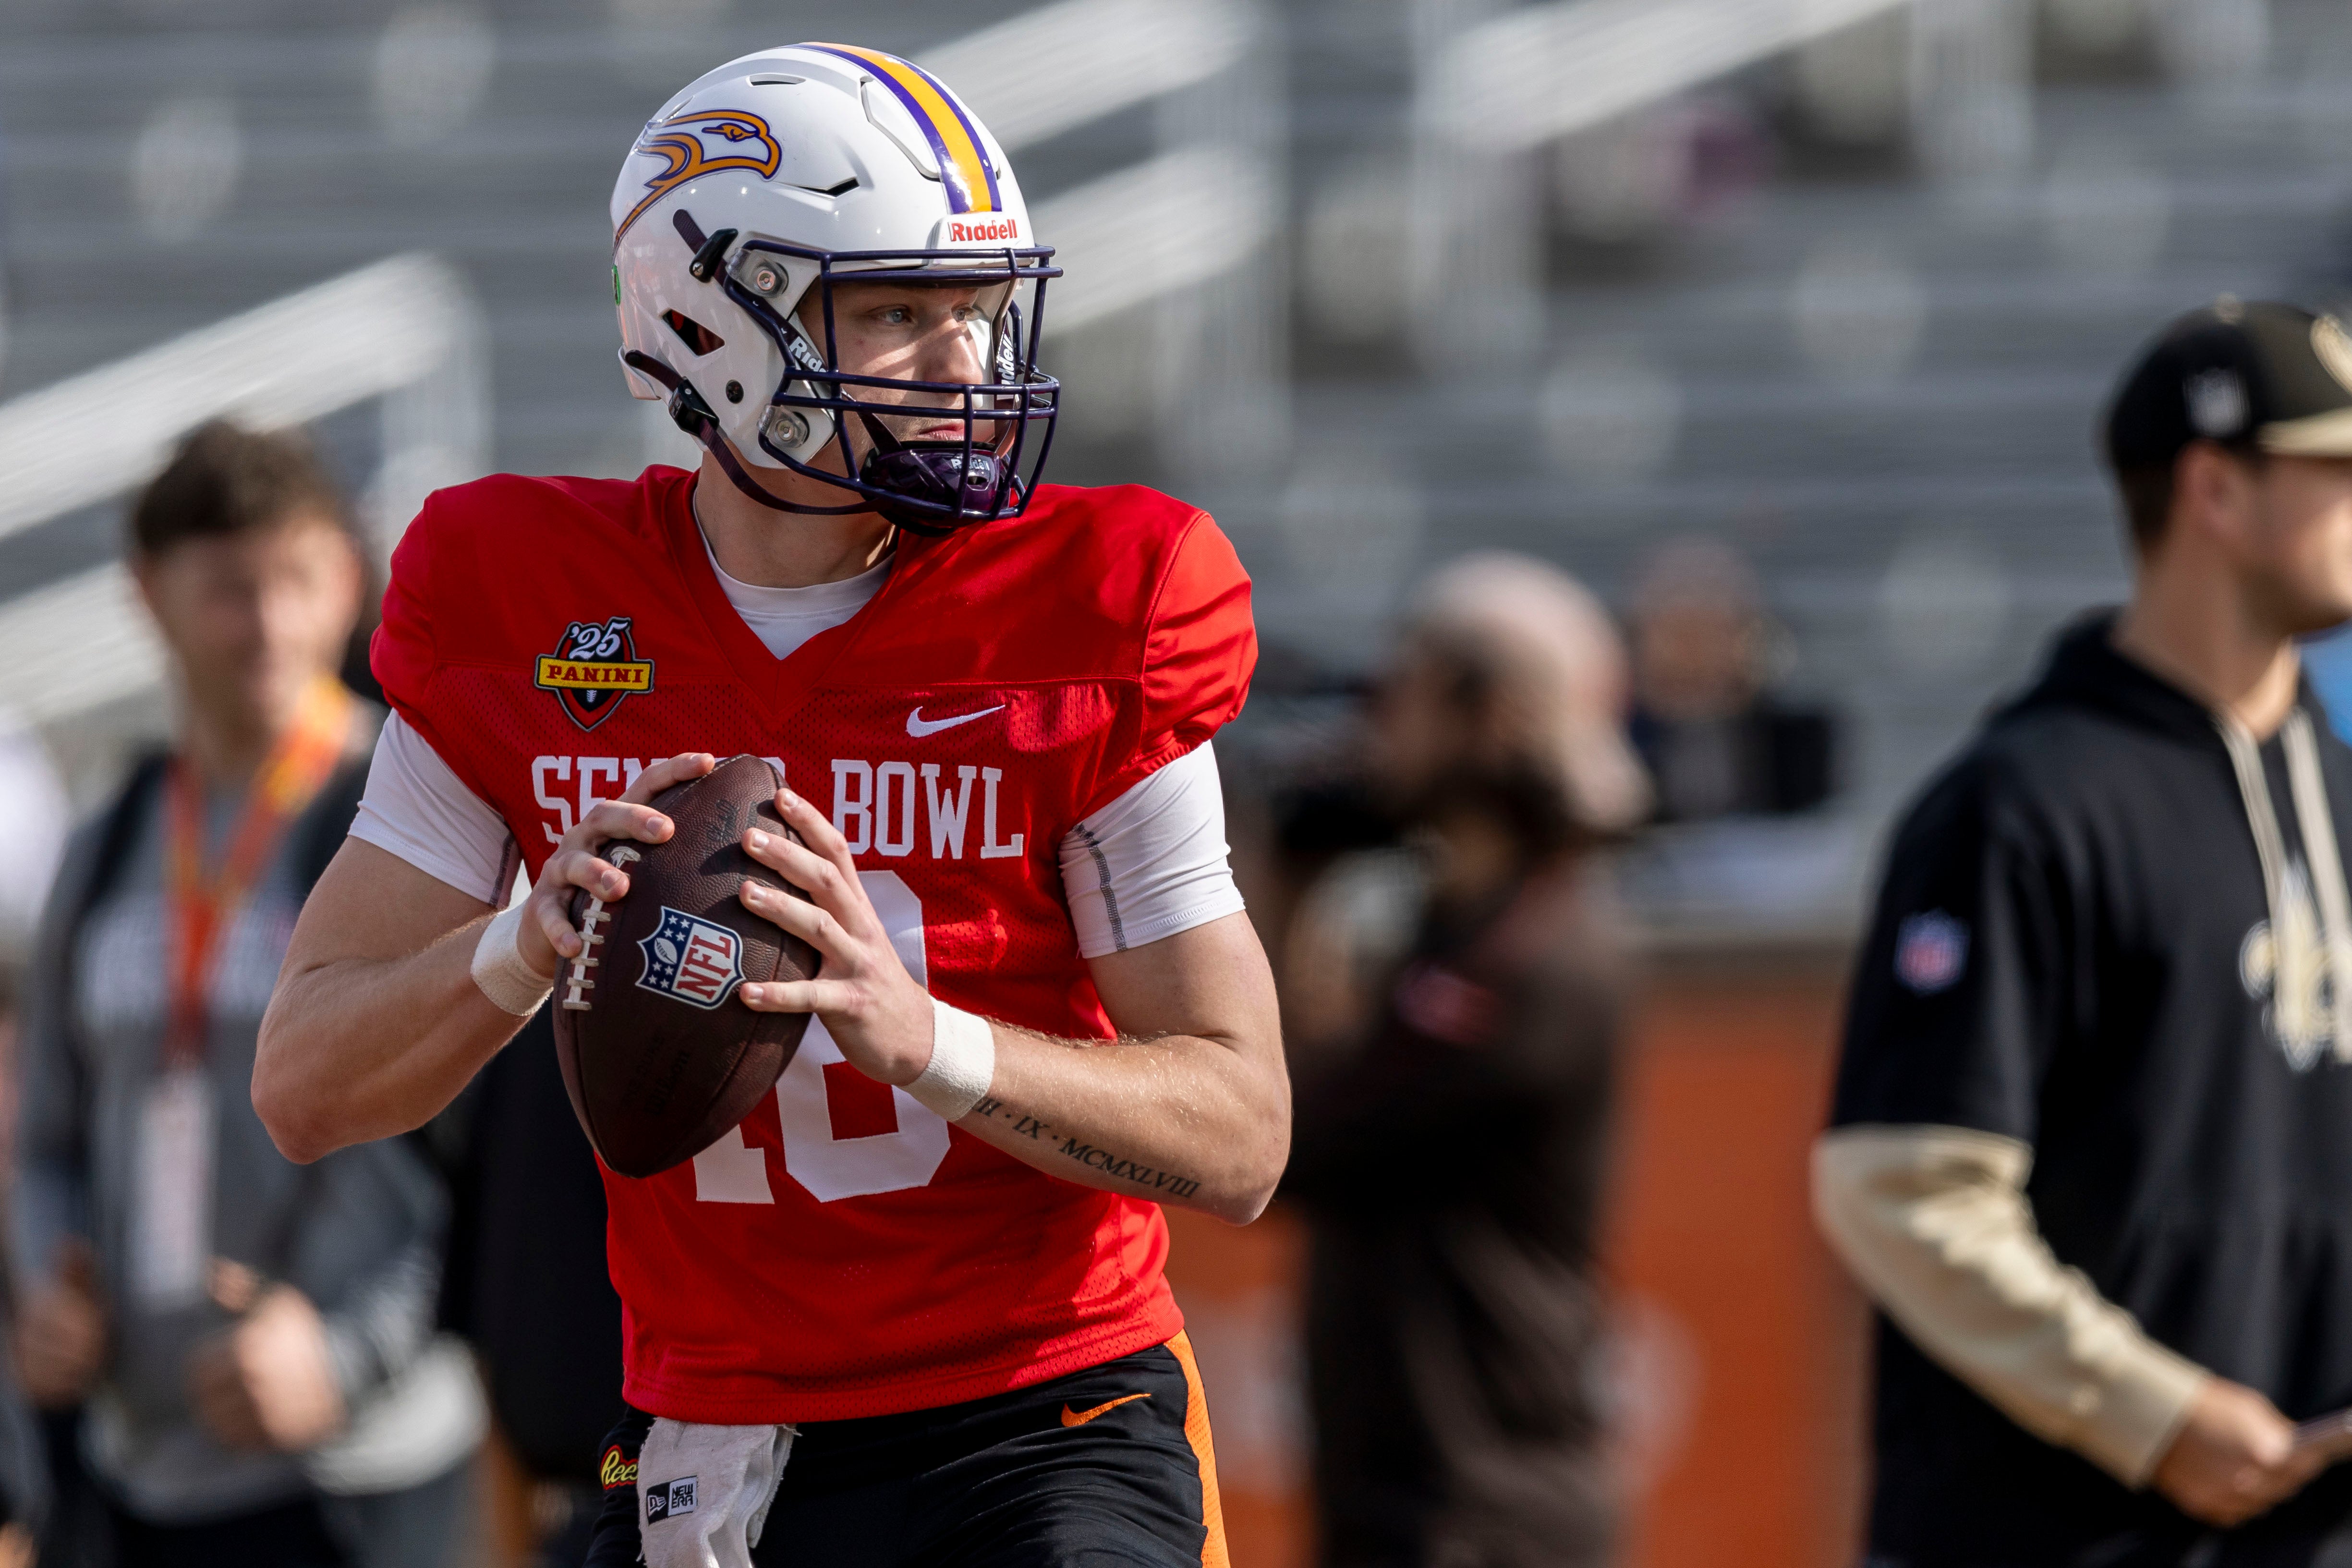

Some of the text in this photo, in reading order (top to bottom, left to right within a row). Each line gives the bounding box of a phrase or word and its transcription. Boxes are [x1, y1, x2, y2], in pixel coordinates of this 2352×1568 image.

[950, 219, 1018, 242] Riddell
[546, 664, 644, 683] PANINI
[831, 759, 1024, 860] BOWL
[676, 935, 732, 1000] NFL
[1012, 1116, 1050, 1140] IX
[1059, 1138, 1201, 1198] MCMXLVIII
[672, 1495, 693, 1509] ERA
[673, 1483, 694, 1499] NEW
